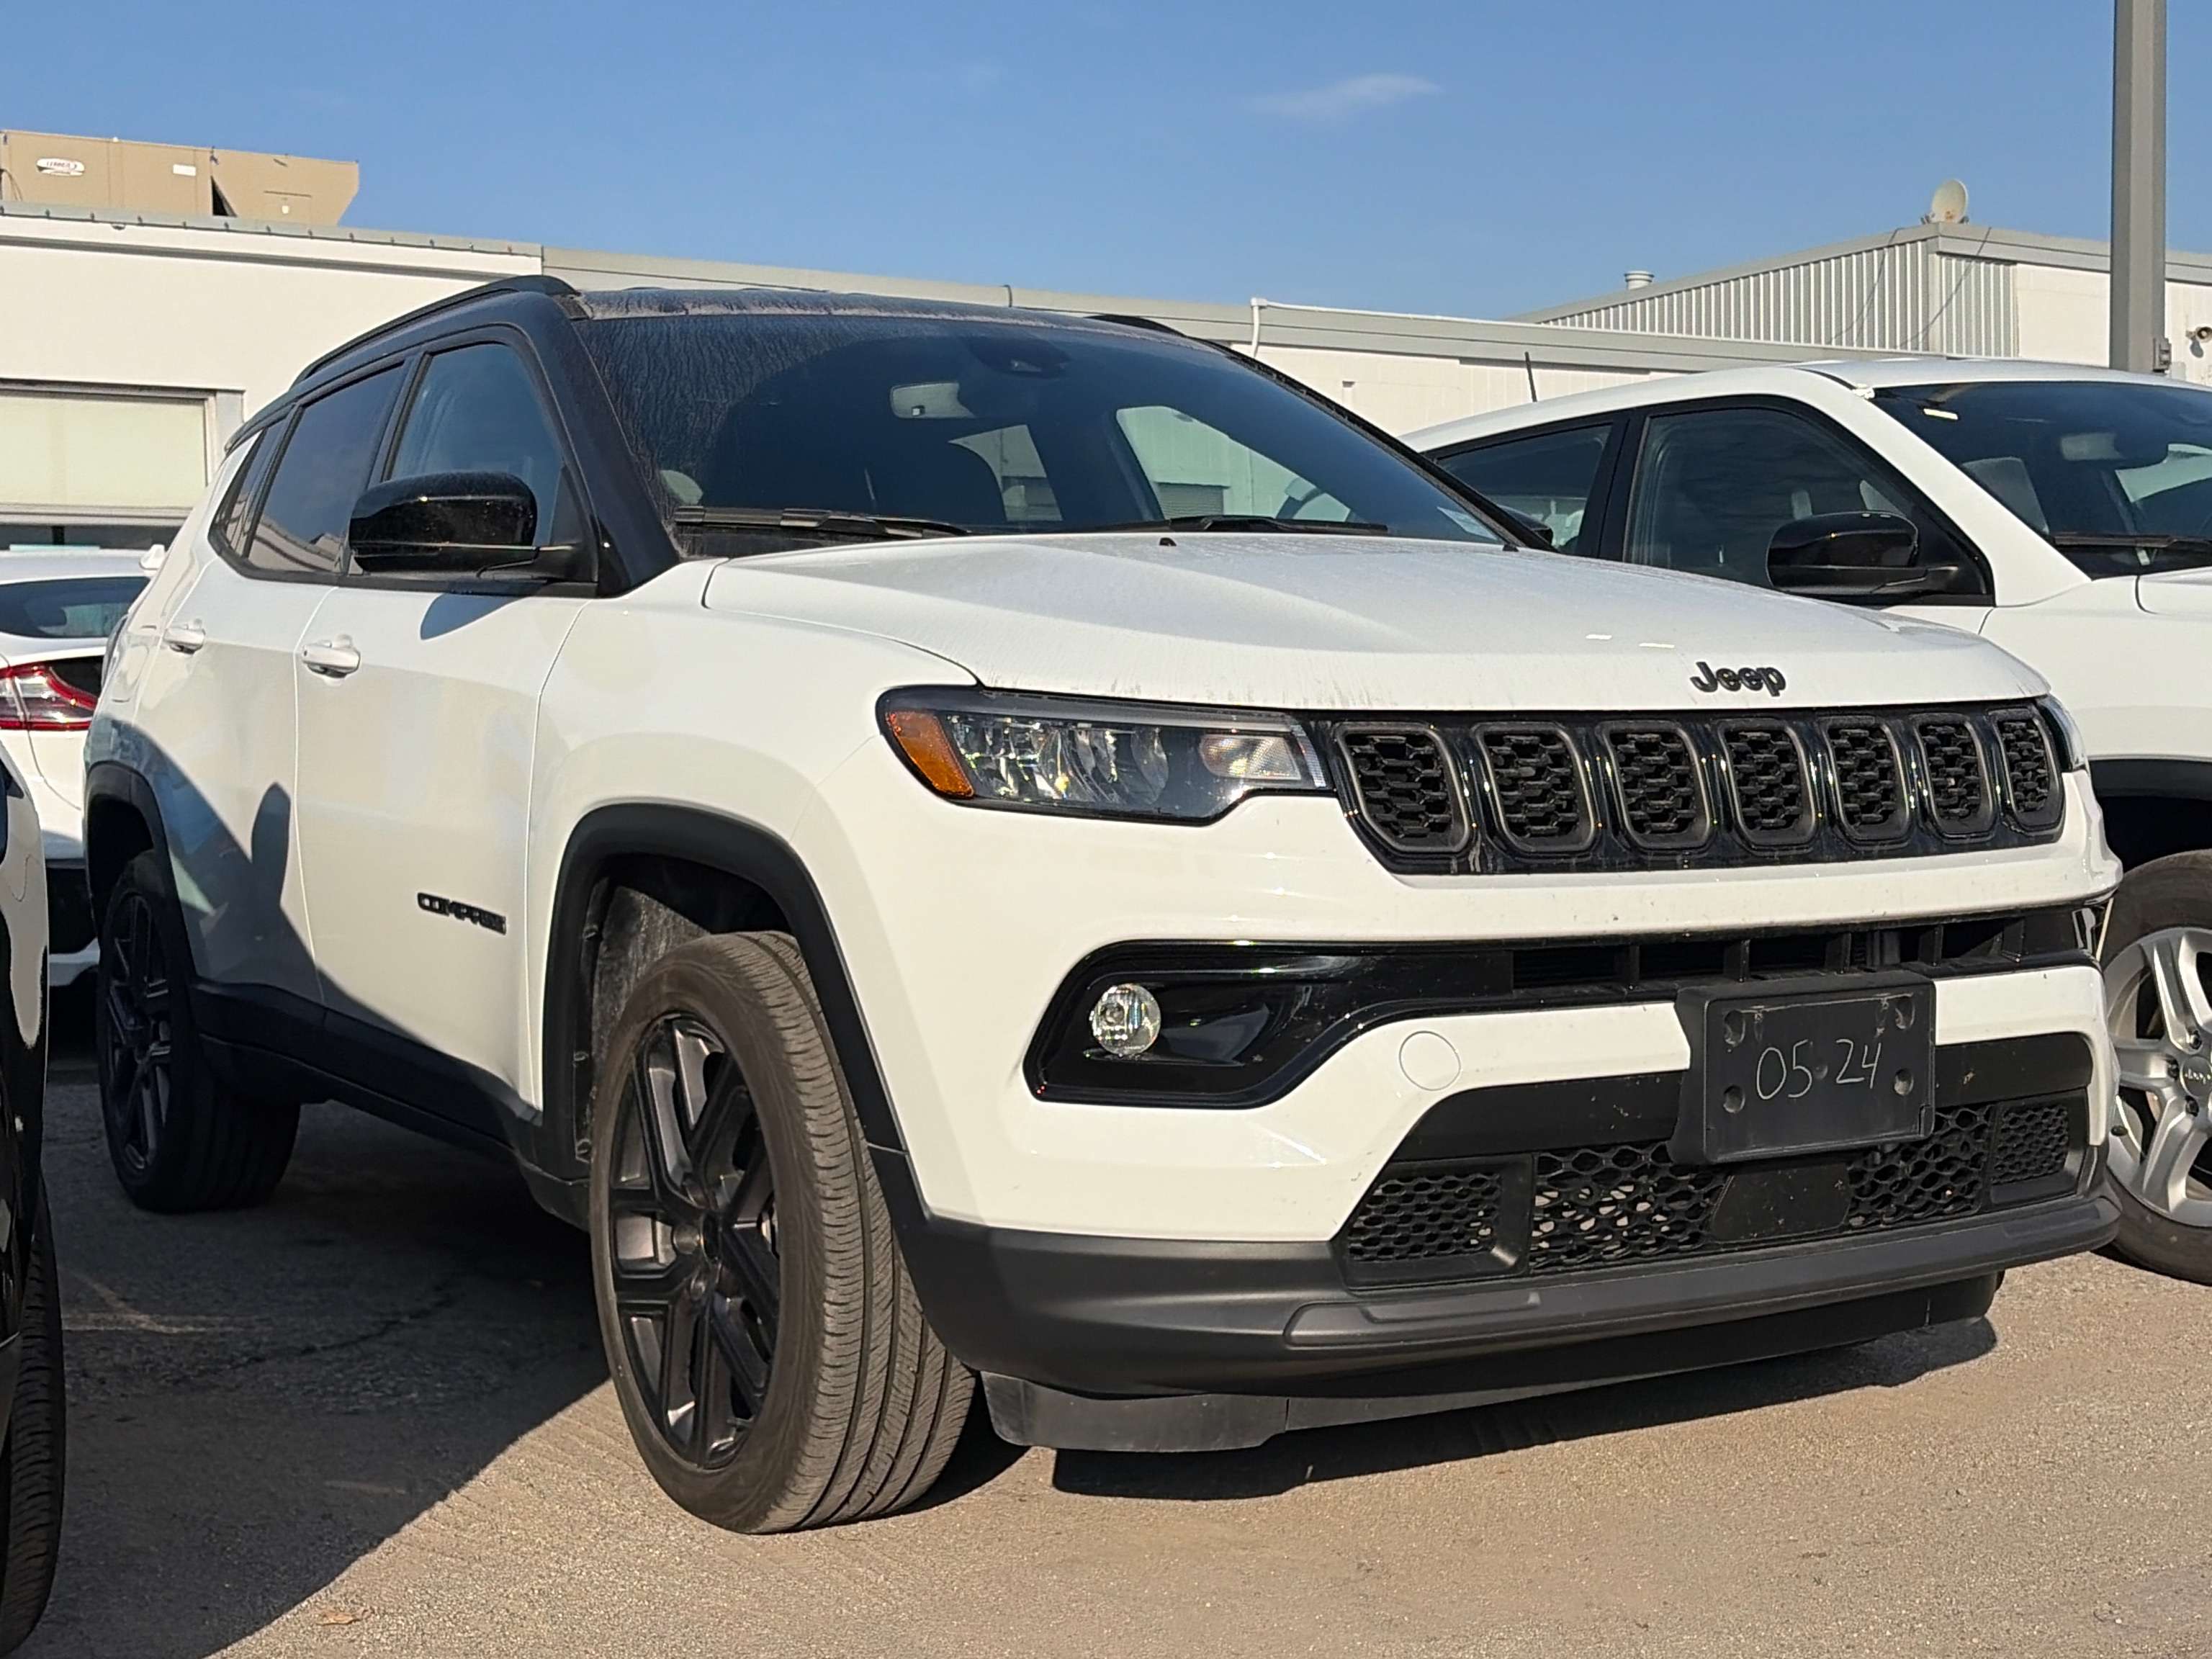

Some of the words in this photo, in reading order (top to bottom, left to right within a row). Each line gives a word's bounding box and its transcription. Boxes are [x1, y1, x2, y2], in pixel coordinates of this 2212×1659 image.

[1690, 662, 1786, 697] Jeep
[1757, 1039, 1813, 1100] 05
[1835, 1038, 1881, 1089] 24
